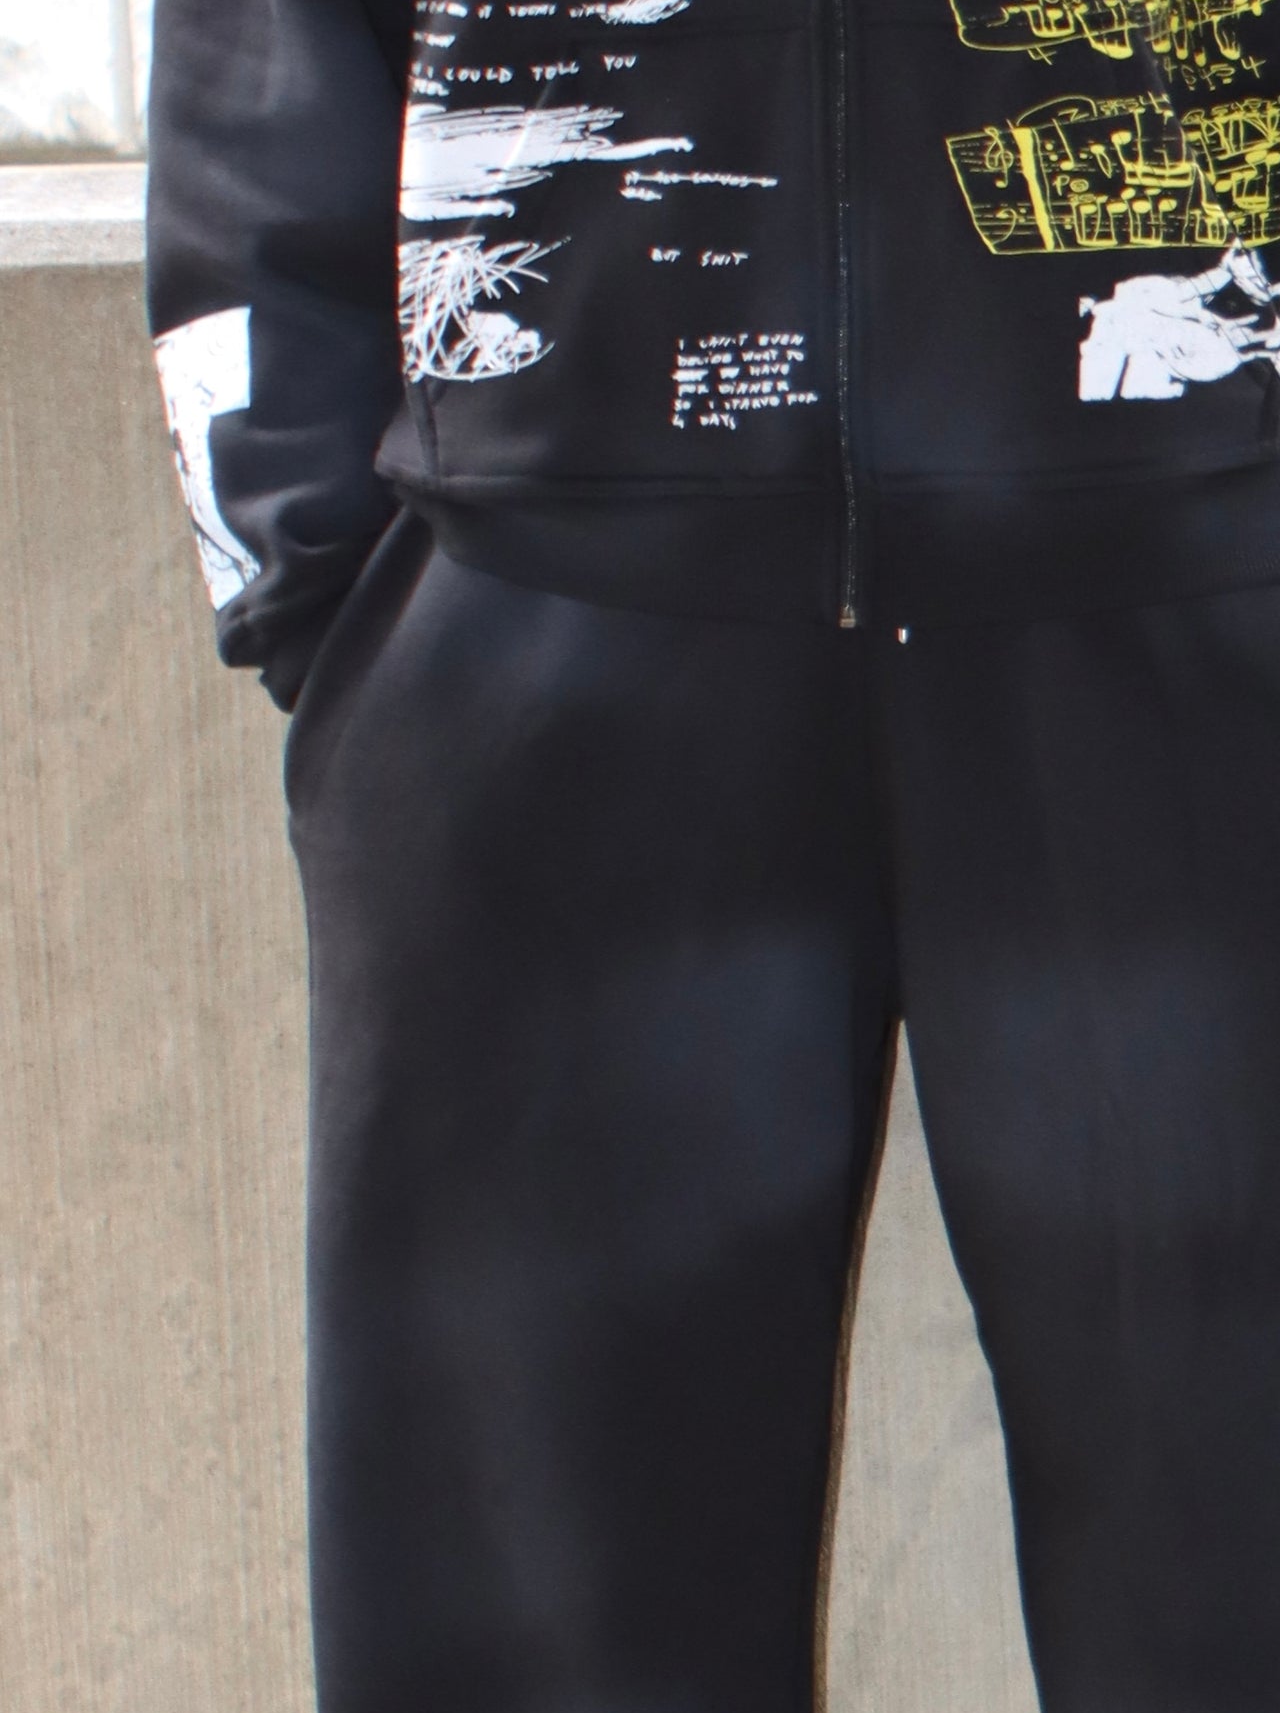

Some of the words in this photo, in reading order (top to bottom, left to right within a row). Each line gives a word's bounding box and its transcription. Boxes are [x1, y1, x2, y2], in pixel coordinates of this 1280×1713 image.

[445, 65, 513, 84] COULD
[531, 61, 580, 82] TELL
[603, 54, 637, 72] YOU
